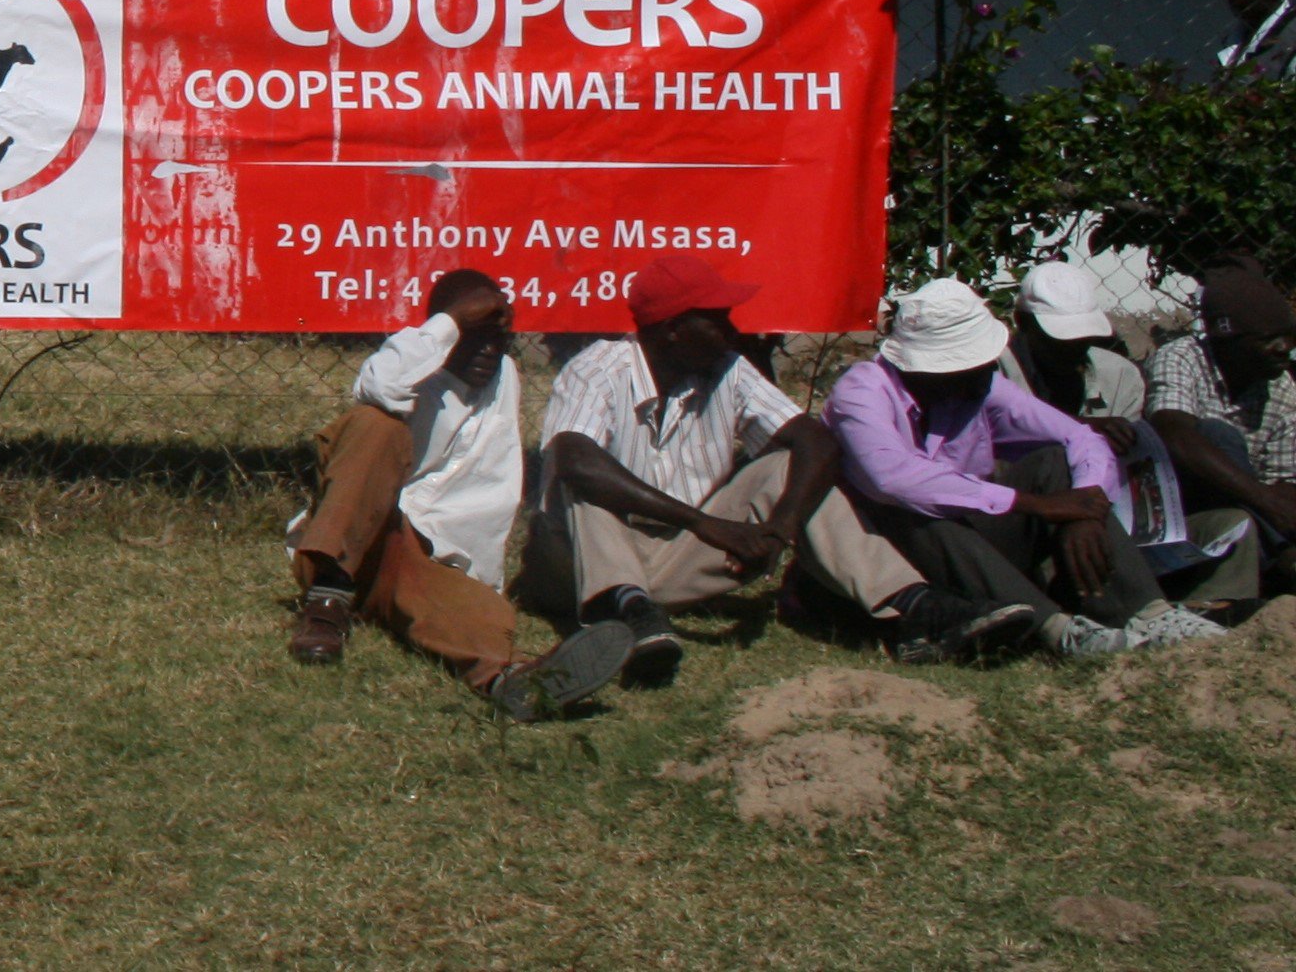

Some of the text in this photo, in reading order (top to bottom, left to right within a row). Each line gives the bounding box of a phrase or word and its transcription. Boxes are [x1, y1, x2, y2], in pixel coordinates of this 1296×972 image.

[184, 68, 422, 110] COOPERS
[437, 71, 640, 111] ANIMAL
[654, 72, 841, 112] HEALTH
[276, 223, 321, 258] 29
[335, 217, 510, 257] Anthony
[524, 221, 600, 249] Ave
[613, 220, 752, 256] Msasa,
[314, 270, 388, 301] Tel:
